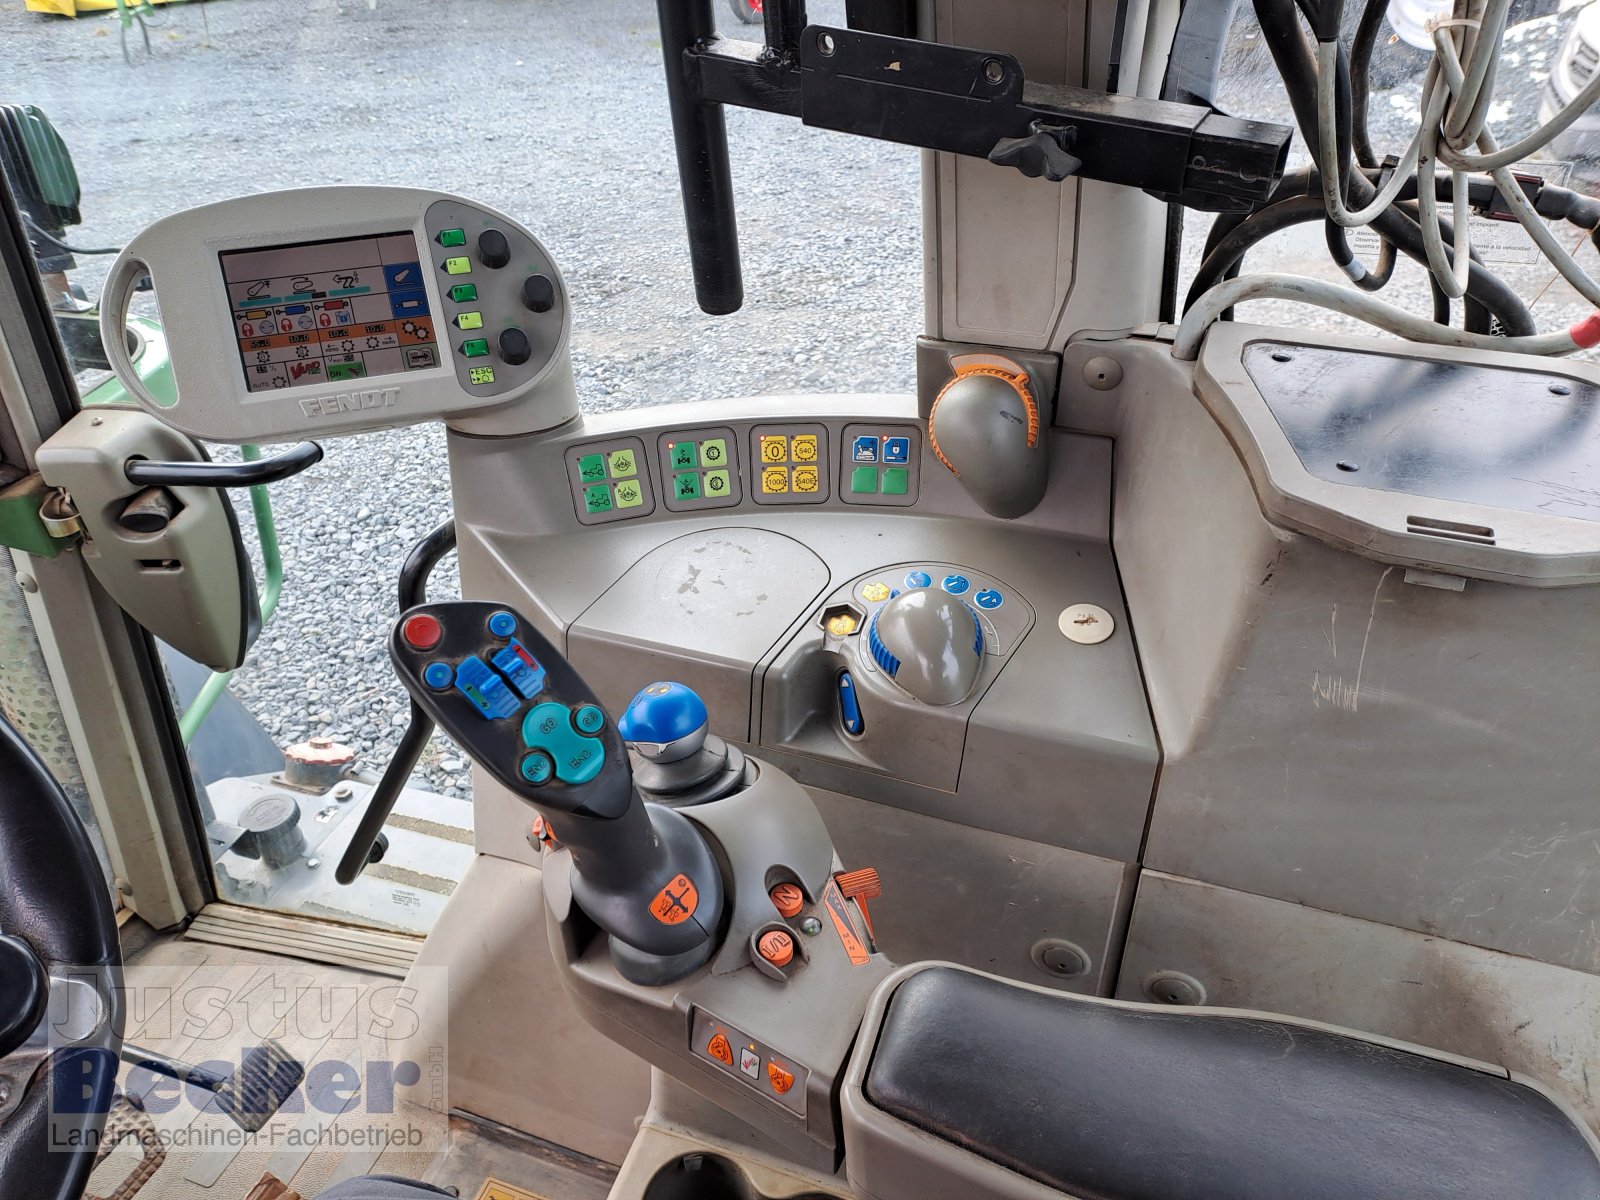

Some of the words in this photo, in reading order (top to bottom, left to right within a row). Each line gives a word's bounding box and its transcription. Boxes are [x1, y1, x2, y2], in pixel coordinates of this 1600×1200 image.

[475, 367, 492, 376] ESC
[299, 387, 400, 417] FENDT
[771, 446, 778, 457] 0
[540, 717, 556, 734] GO
[582, 712, 597, 727] GO
[568, 749, 592, 769] END
[527, 759, 546, 778] END
